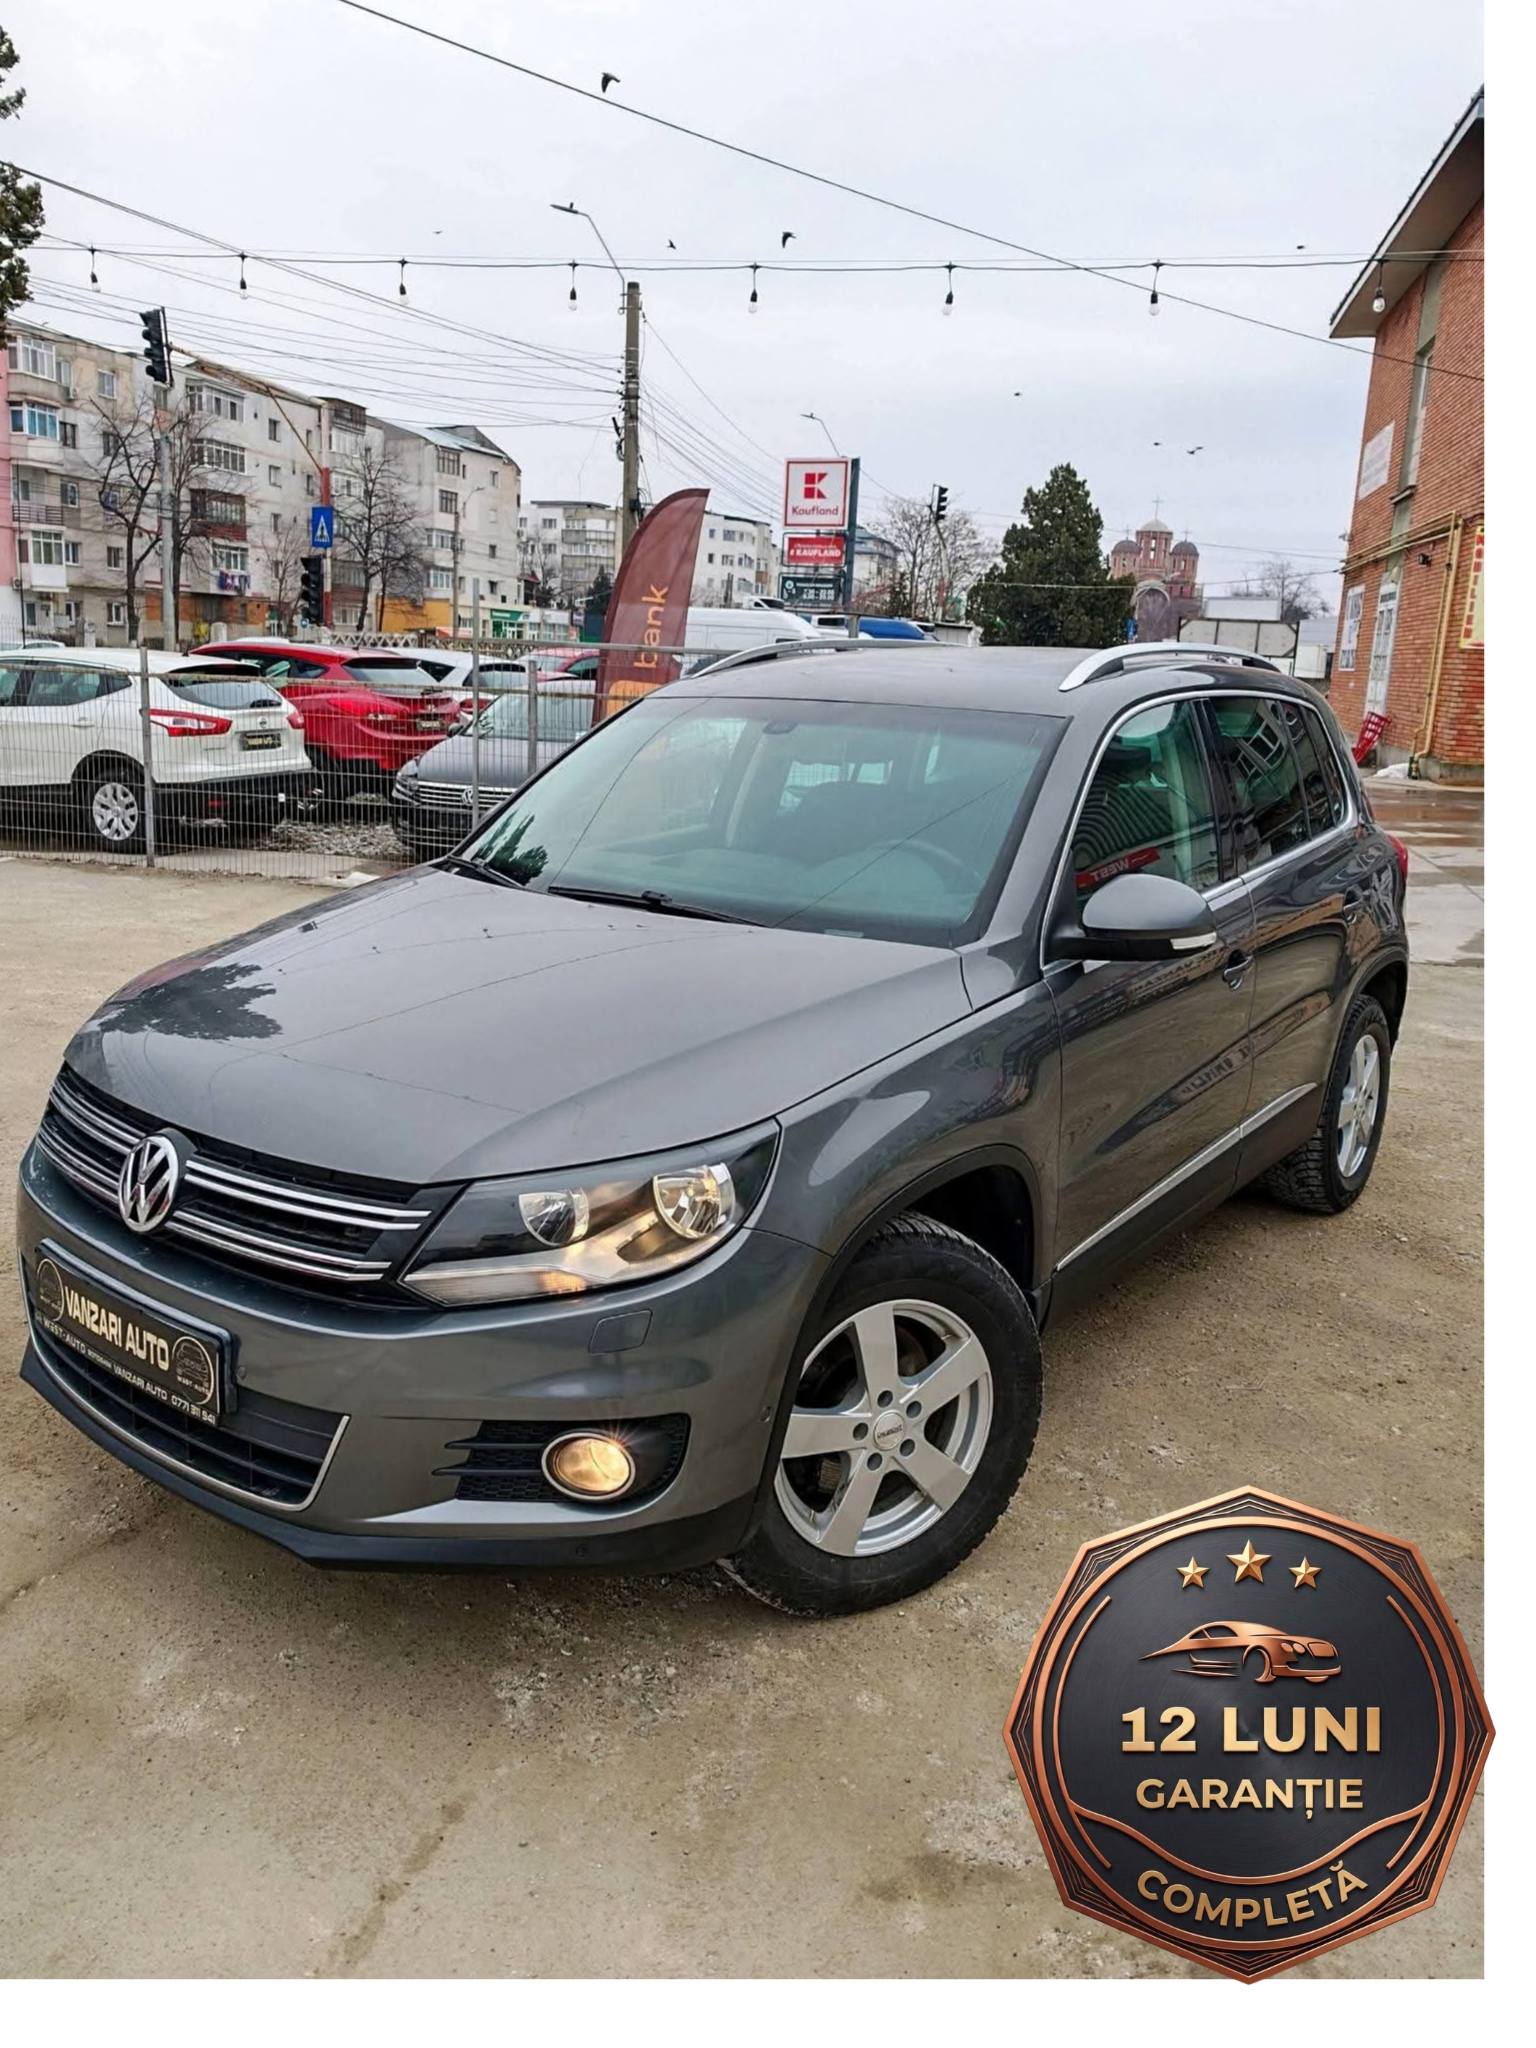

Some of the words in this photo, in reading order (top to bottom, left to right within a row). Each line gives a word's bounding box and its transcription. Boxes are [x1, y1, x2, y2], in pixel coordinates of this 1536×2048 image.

[803, 472, 828, 500] K
[791, 505, 839, 516] Kaufland
[796, 548, 841, 558] KAUFLAND
[633, 583, 669, 668] bank
[64, 1285, 122, 1348] VANZARI
[125, 1321, 170, 1372] AUTO
[113, 1363, 145, 1390] VANZARI
[145, 1382, 168, 1400] AUTO
[171, 1395, 190, 1412] 0771
